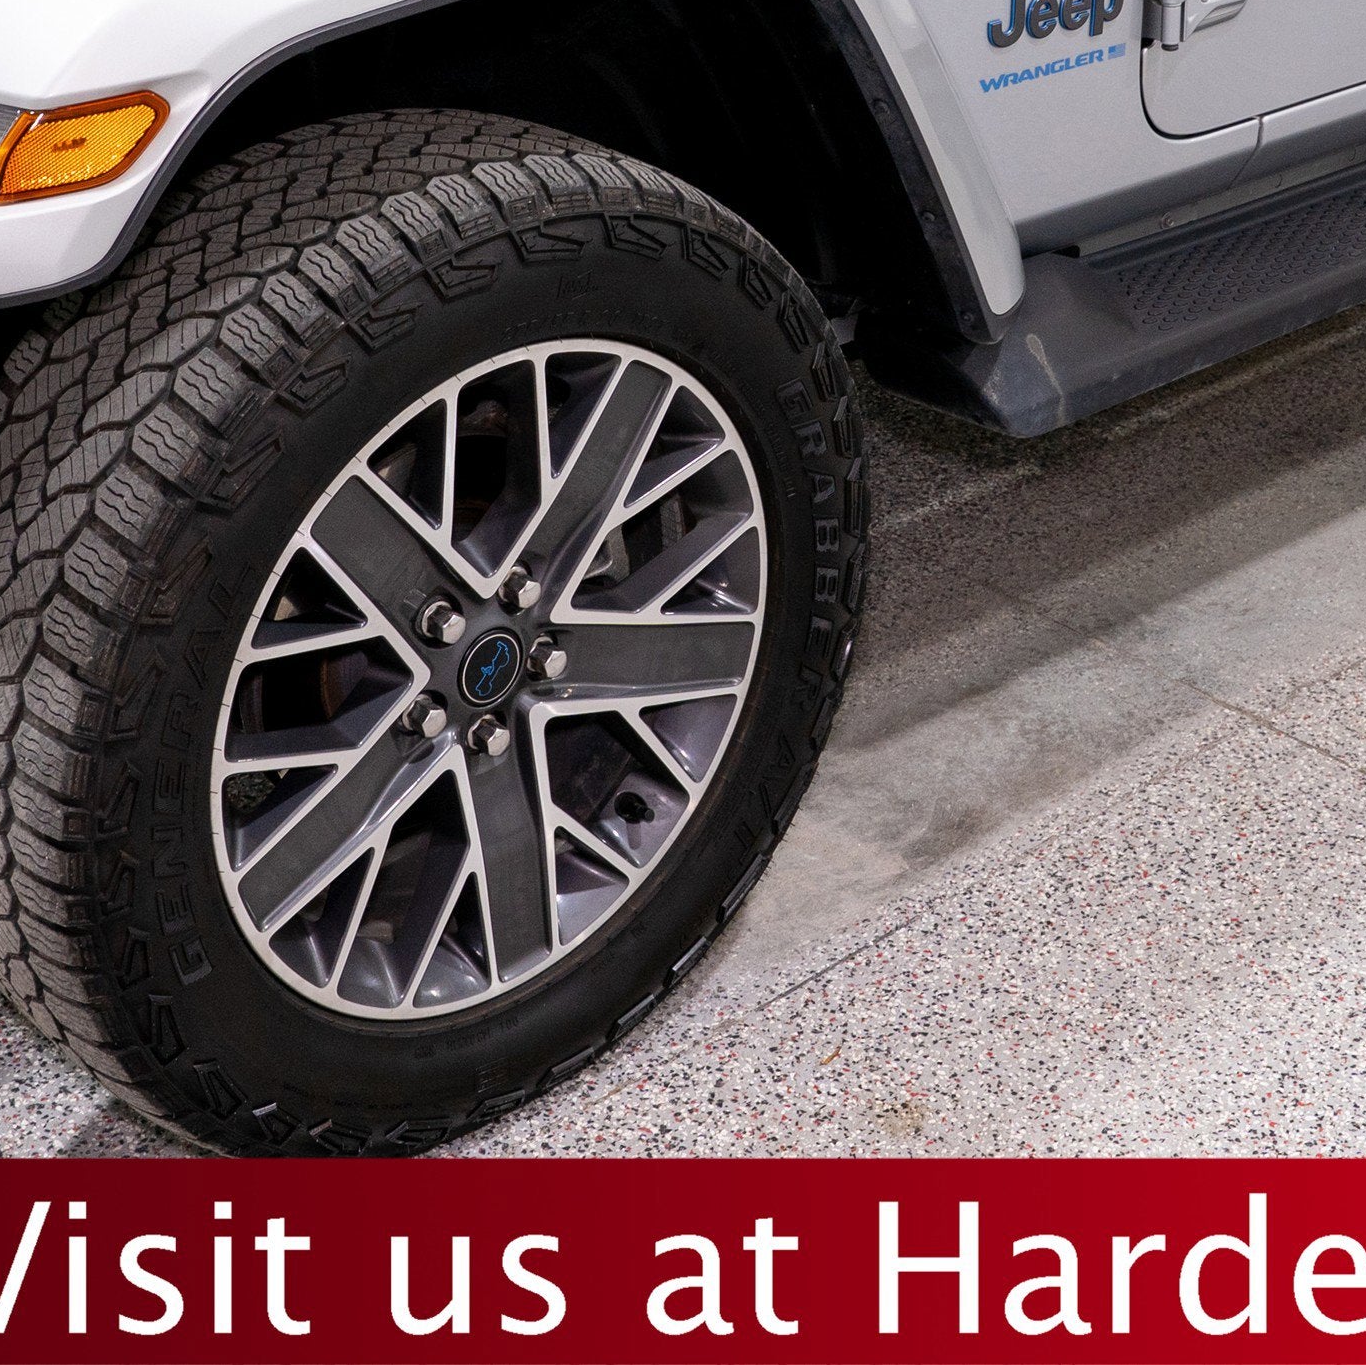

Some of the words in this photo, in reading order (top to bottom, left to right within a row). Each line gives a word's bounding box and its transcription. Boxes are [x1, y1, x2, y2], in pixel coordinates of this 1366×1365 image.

[979, 48, 1104, 93] WRANGLER
[775, 376, 840, 715] GRABBER
[151, 561, 256, 986] GENERAL
